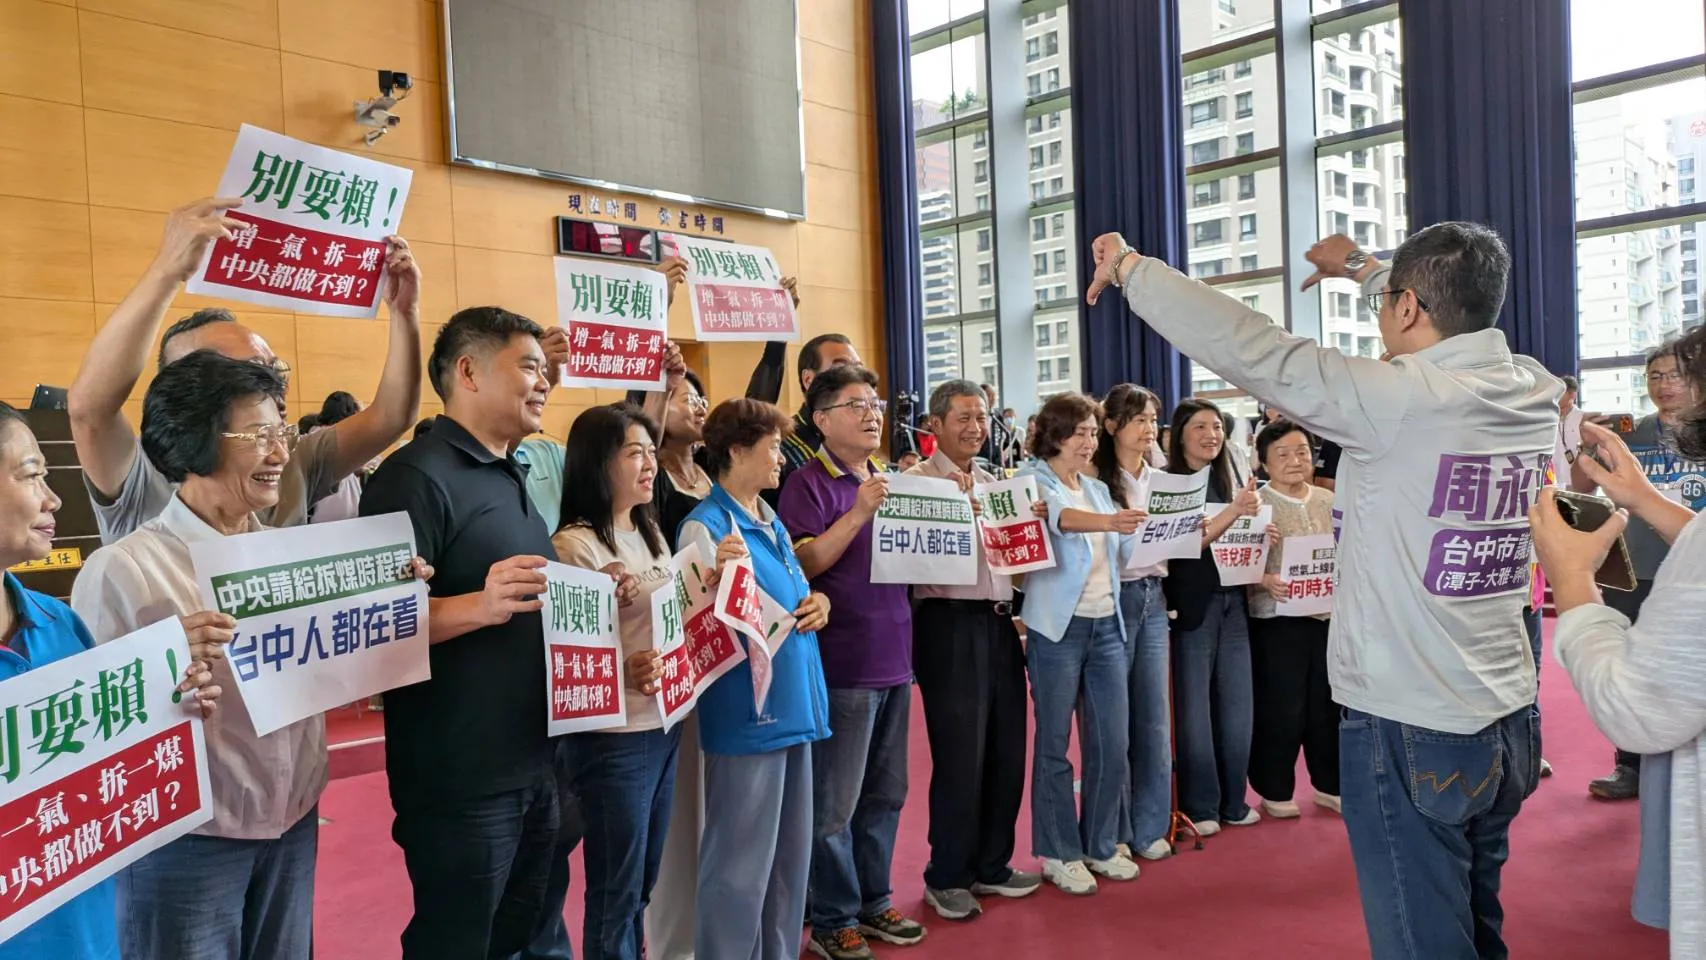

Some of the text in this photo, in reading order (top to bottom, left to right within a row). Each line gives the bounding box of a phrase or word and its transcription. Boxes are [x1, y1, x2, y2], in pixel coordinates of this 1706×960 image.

[242, 150, 398, 228] 別耍賴！
[220, 253, 369, 299] 中央都做不到？
[571, 351, 655, 376] 中央都做不到？
[1682, 482, 1702, 497] 86
[549, 580, 613, 636] 別耍賴！
